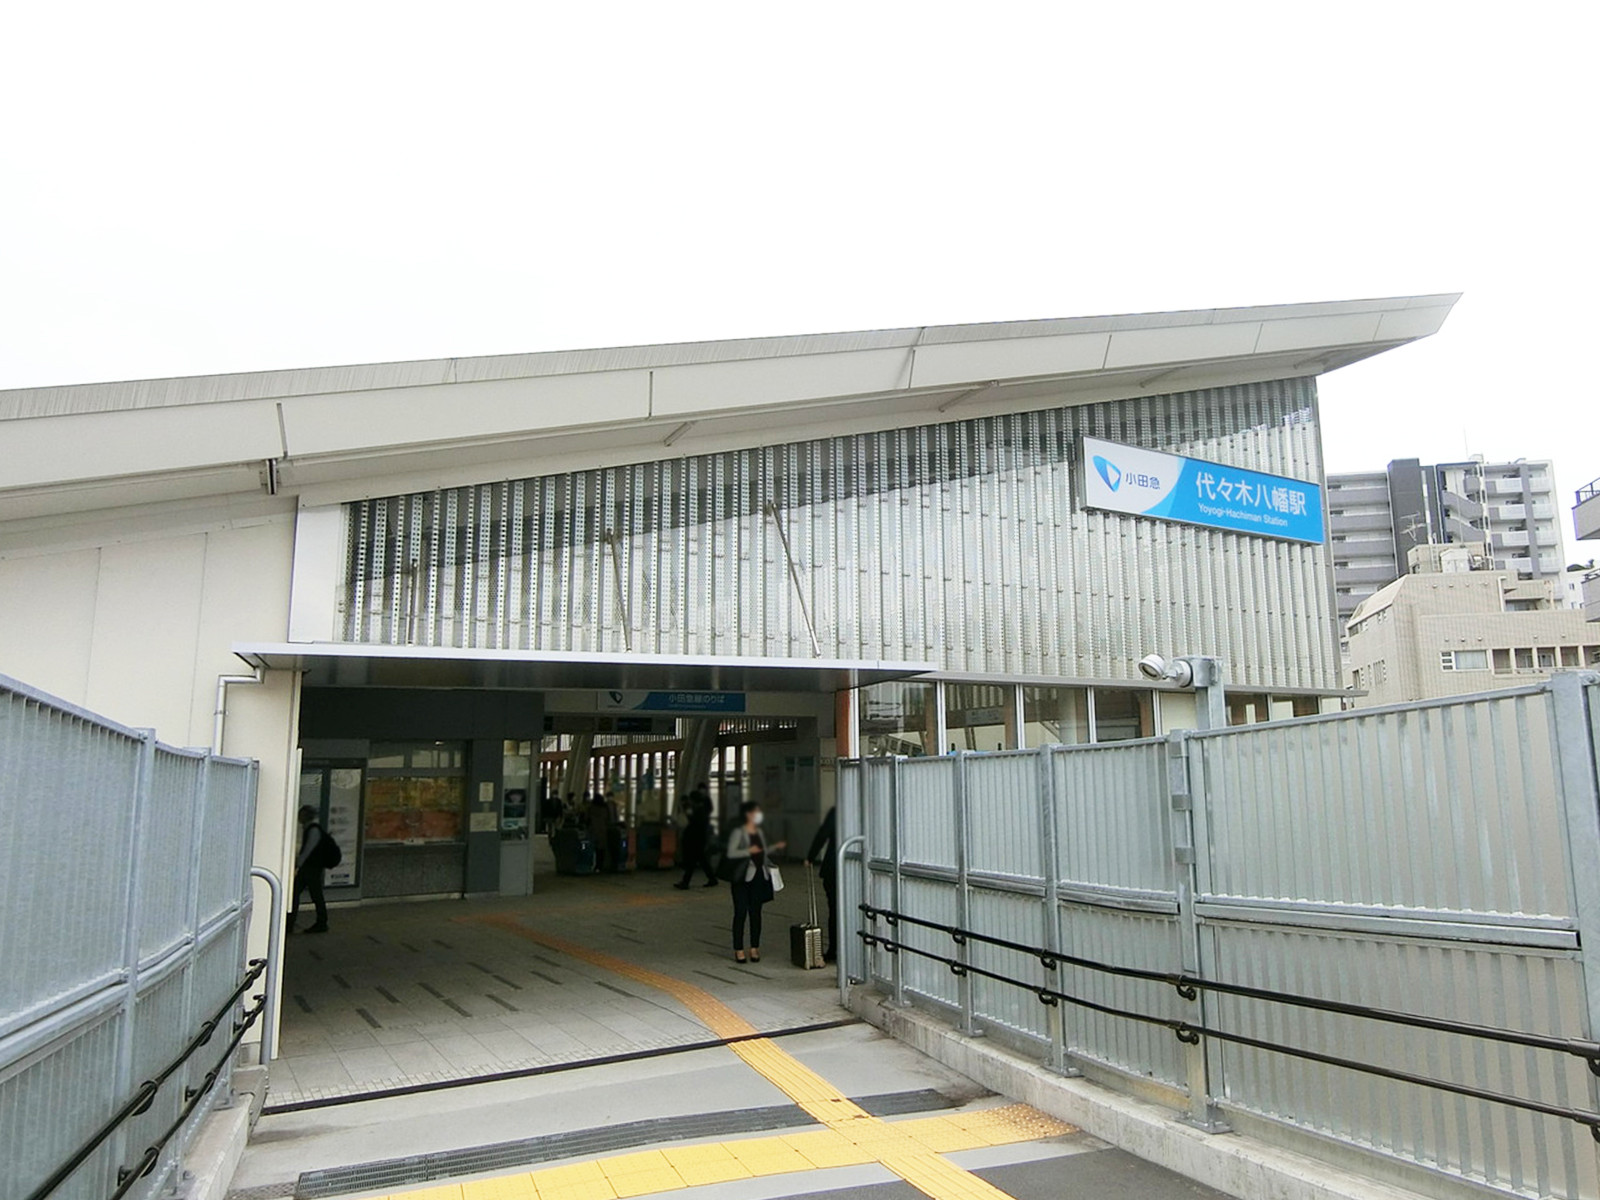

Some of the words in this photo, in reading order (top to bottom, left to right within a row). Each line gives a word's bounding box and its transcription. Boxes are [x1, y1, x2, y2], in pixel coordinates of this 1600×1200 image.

[1125, 472, 1161, 490] 小田急
[1196, 471, 1307, 516] 代々木八幡駅
[1198, 502, 1262, 522] Yoyogi-Hachiman
[1263, 514, 1288, 527] Station
